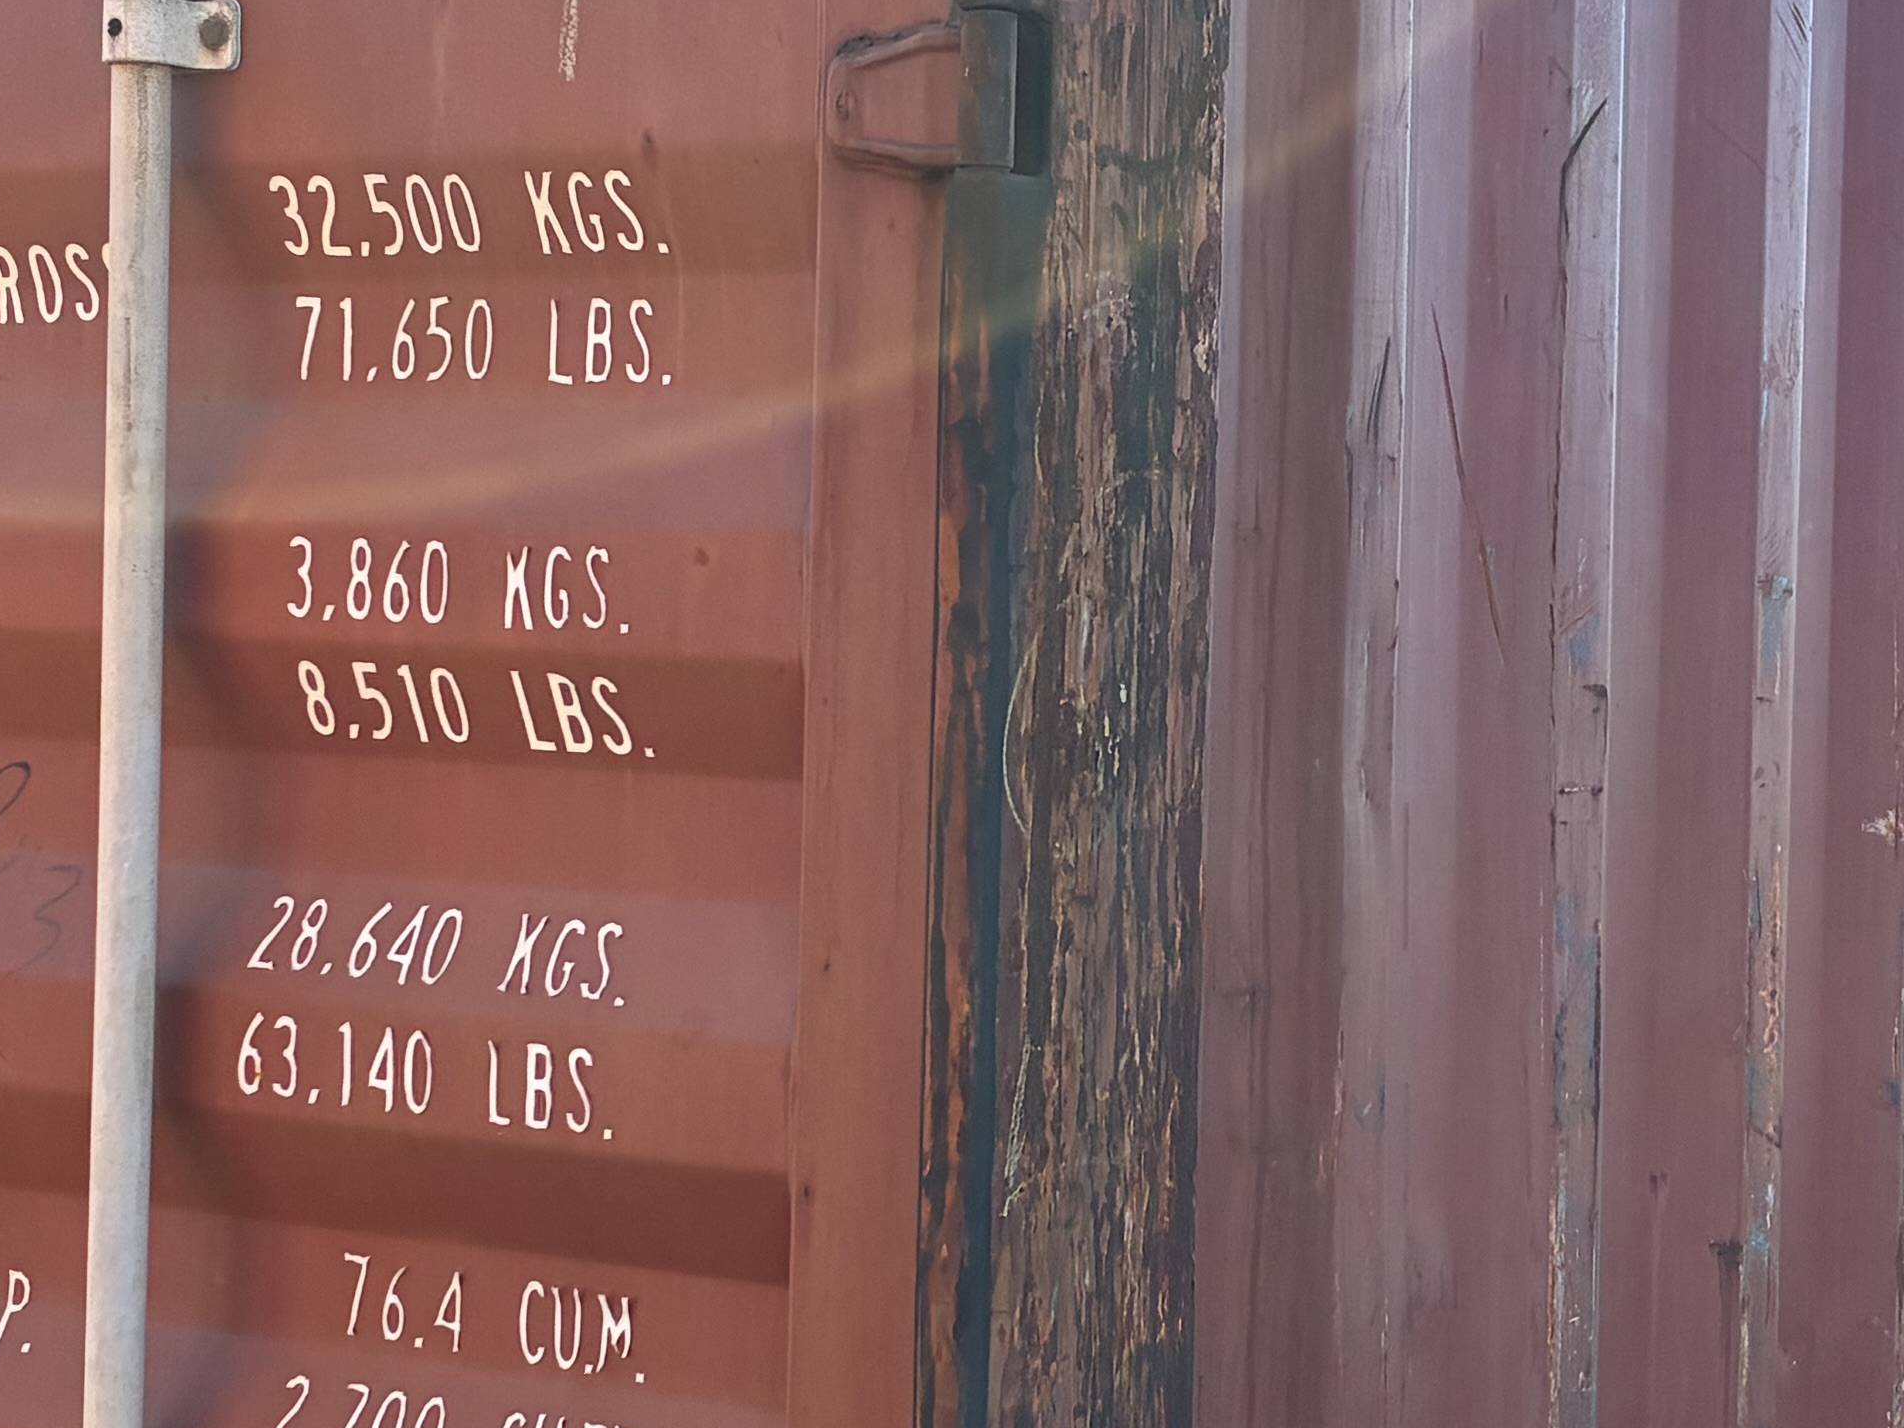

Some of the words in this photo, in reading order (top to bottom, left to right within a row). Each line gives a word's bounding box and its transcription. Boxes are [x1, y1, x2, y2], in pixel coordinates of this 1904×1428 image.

[524, 169, 670, 256] KGS.
[547, 296, 673, 386] LBS.
[504, 545, 630, 635] KGS.
[509, 669, 656, 759] LBS.
[497, 913, 626, 1007] KGS.
[486, 1039, 614, 1141] LBS.
[343, 1252, 463, 1353] 76.4
